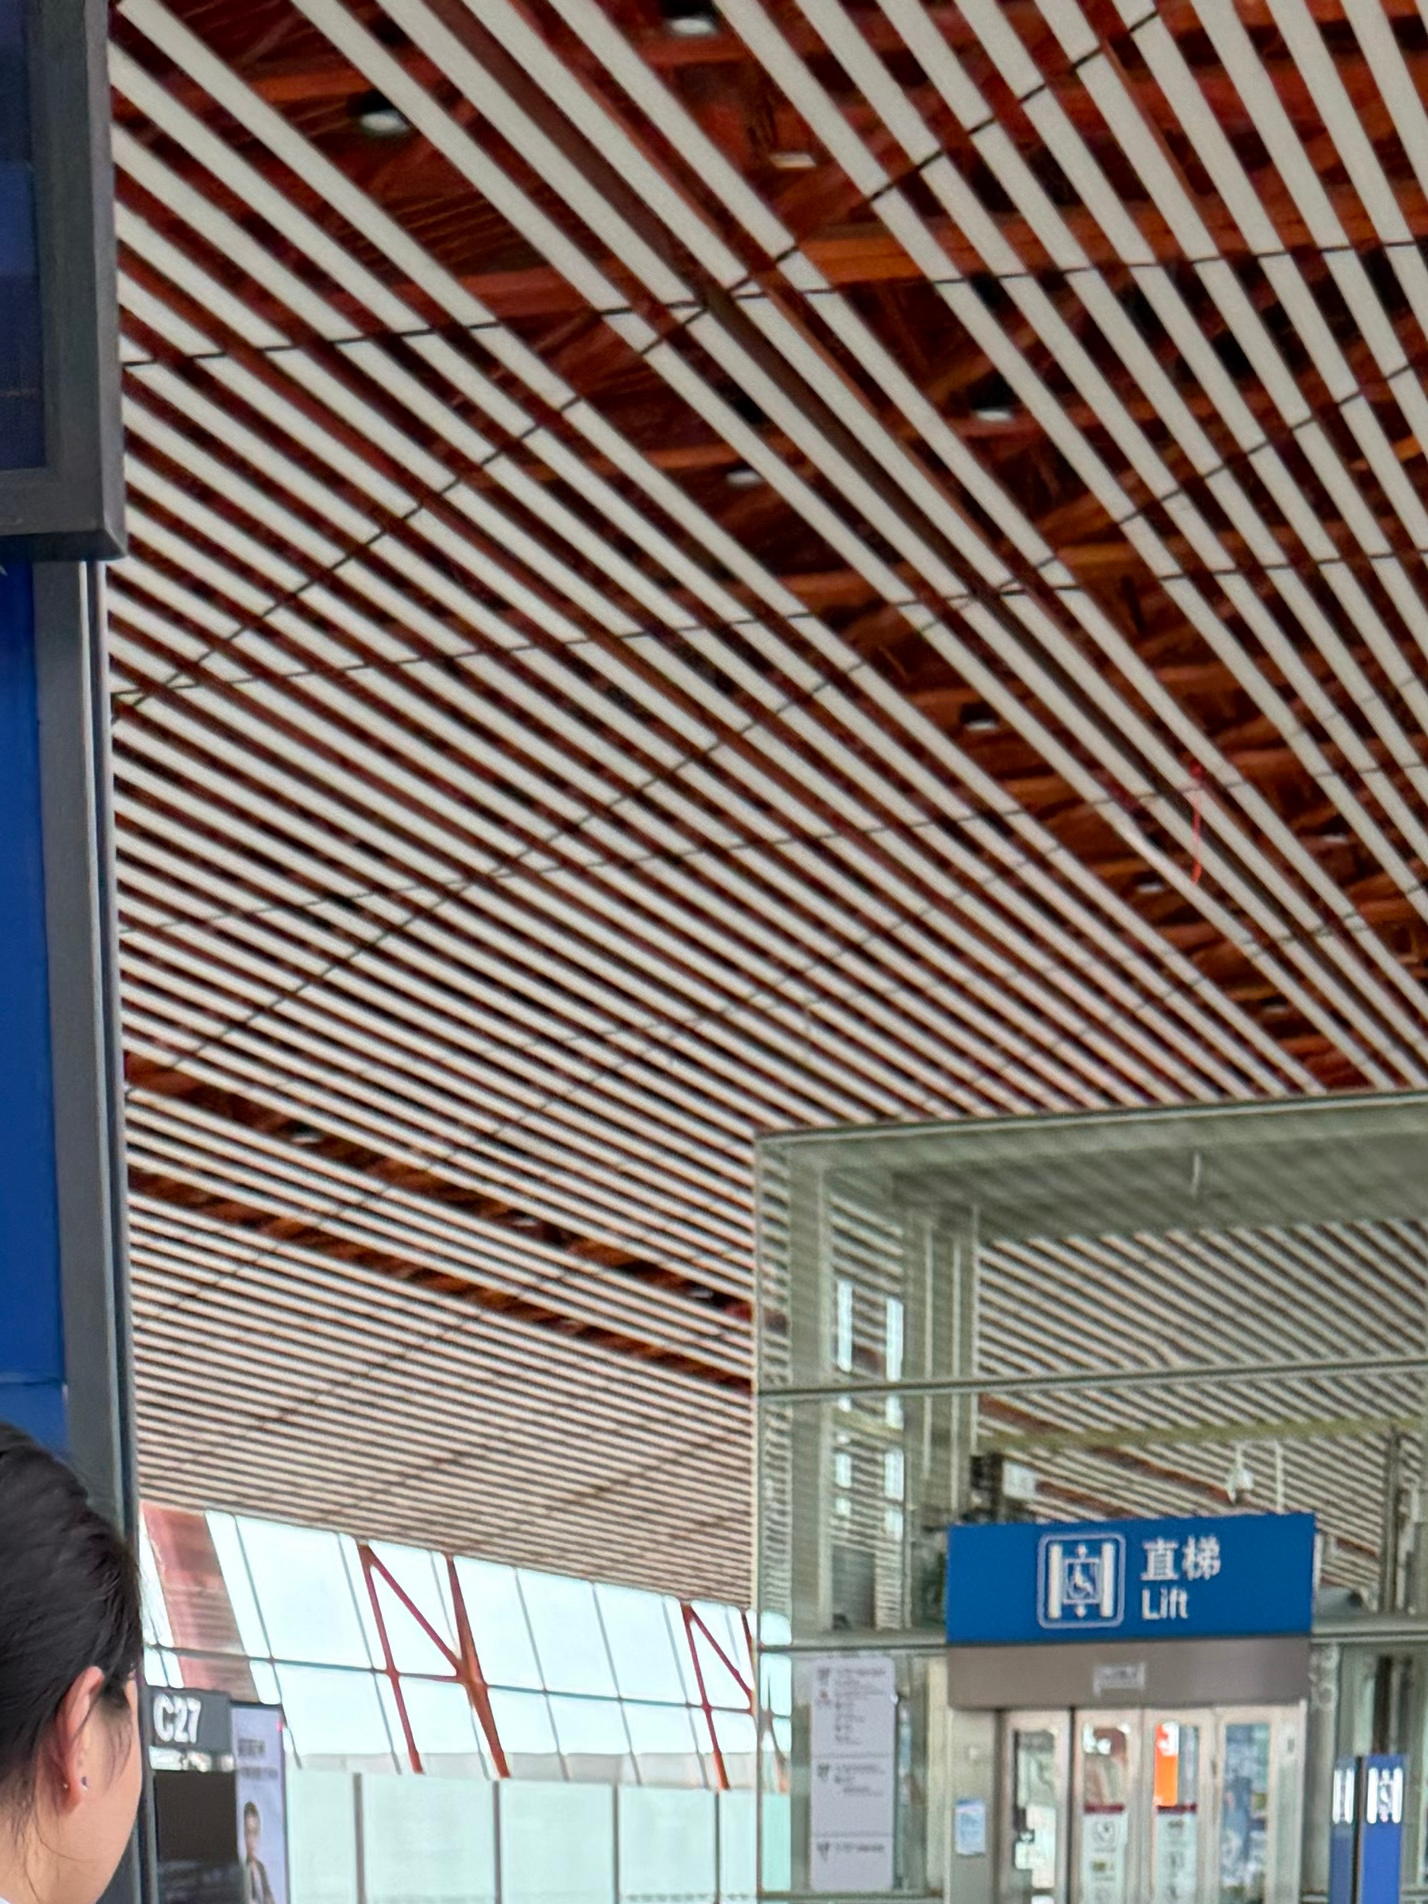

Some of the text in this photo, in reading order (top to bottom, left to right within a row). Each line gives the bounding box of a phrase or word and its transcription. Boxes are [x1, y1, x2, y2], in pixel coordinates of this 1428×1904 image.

[1140, 1533, 1222, 1581] 直梯
[1141, 1587, 1189, 1620] Lift
[152, 1692, 202, 1744] C27
